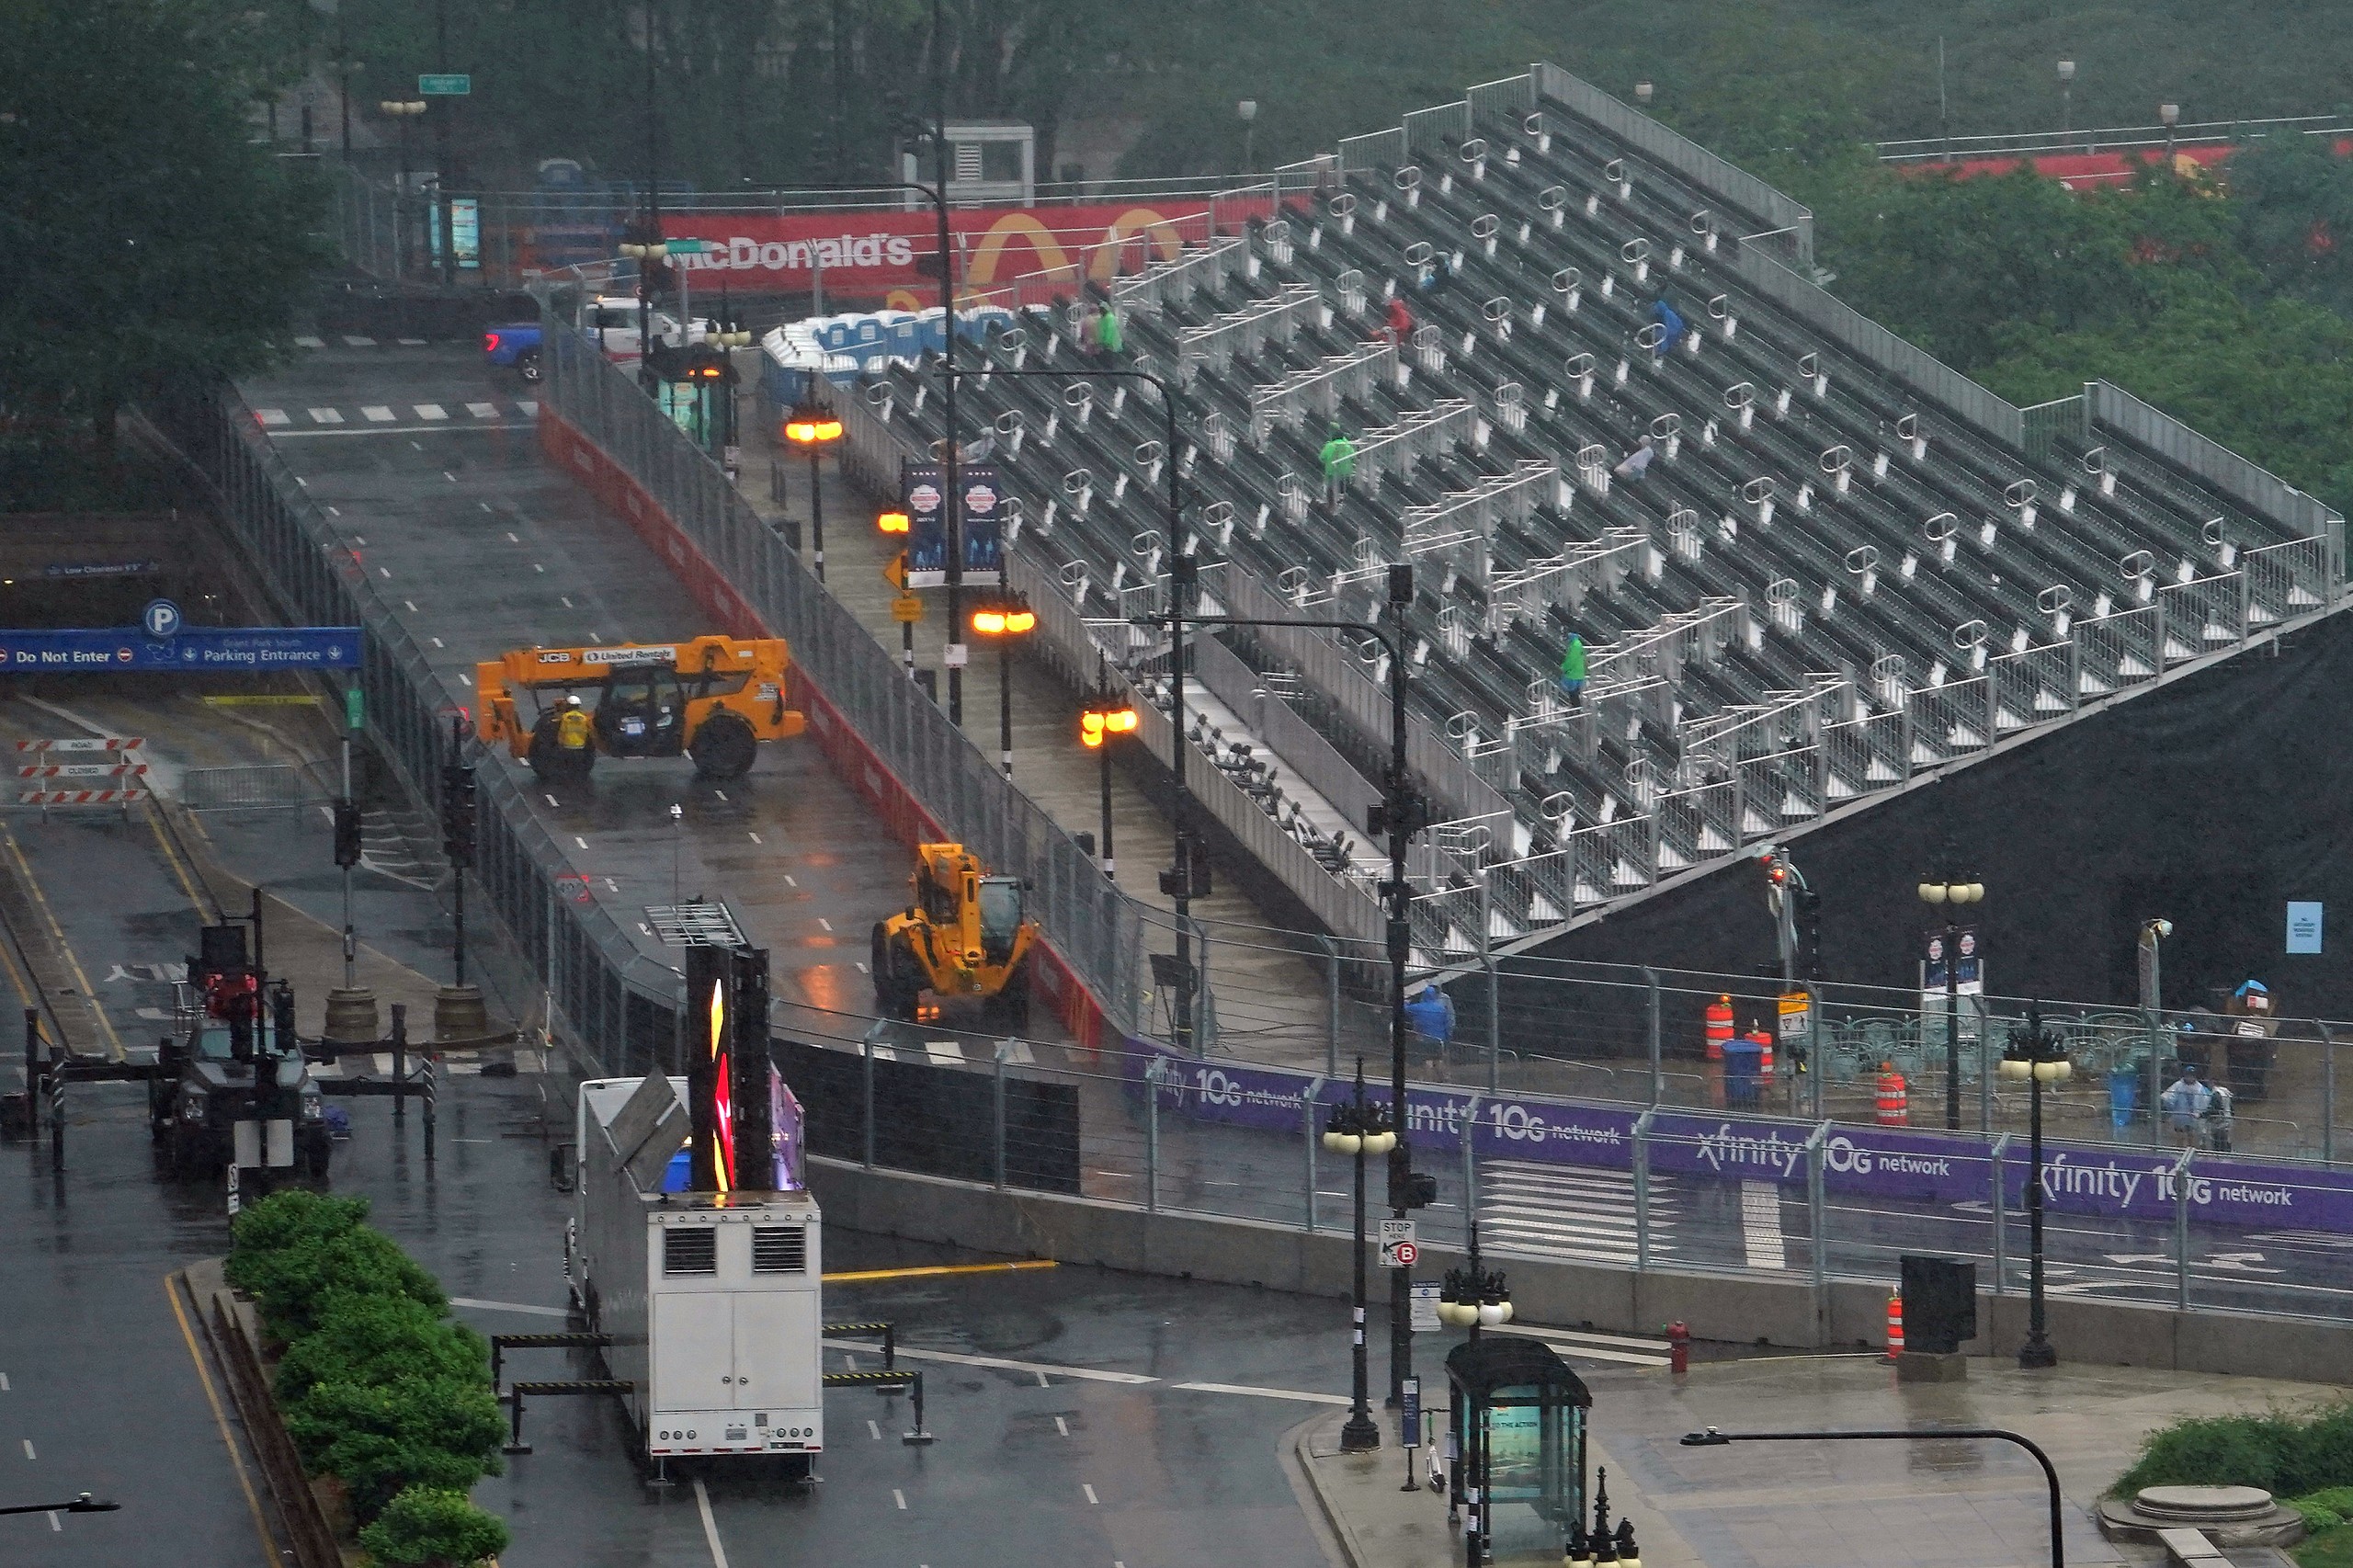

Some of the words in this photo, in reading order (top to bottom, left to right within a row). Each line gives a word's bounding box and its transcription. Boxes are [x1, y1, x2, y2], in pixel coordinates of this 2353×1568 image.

[153, 608, 174, 632] P
[16, 651, 37, 664] Do
[42, 651, 68, 664] Not
[73, 651, 111, 664] Enter
[204, 649, 256, 664] Parking
[260, 649, 321, 661] Entrance
[539, 653, 570, 663] JCB
[600, 652, 633, 661] United
[635, 649, 671, 660] Rentals
[1197, 1067, 1241, 1107] 10G
[1246, 1088, 1302, 1110] network
[1489, 1103, 1546, 1143] 10G
[1551, 1123, 1620, 1146] network
[1696, 1123, 1802, 1178] xfinity
[1879, 1154, 1950, 1177] network
[2219, 1184, 2292, 1207] network
[1383, 1222, 1412, 1233] STOP
[1401, 1246, 1414, 1260] B
